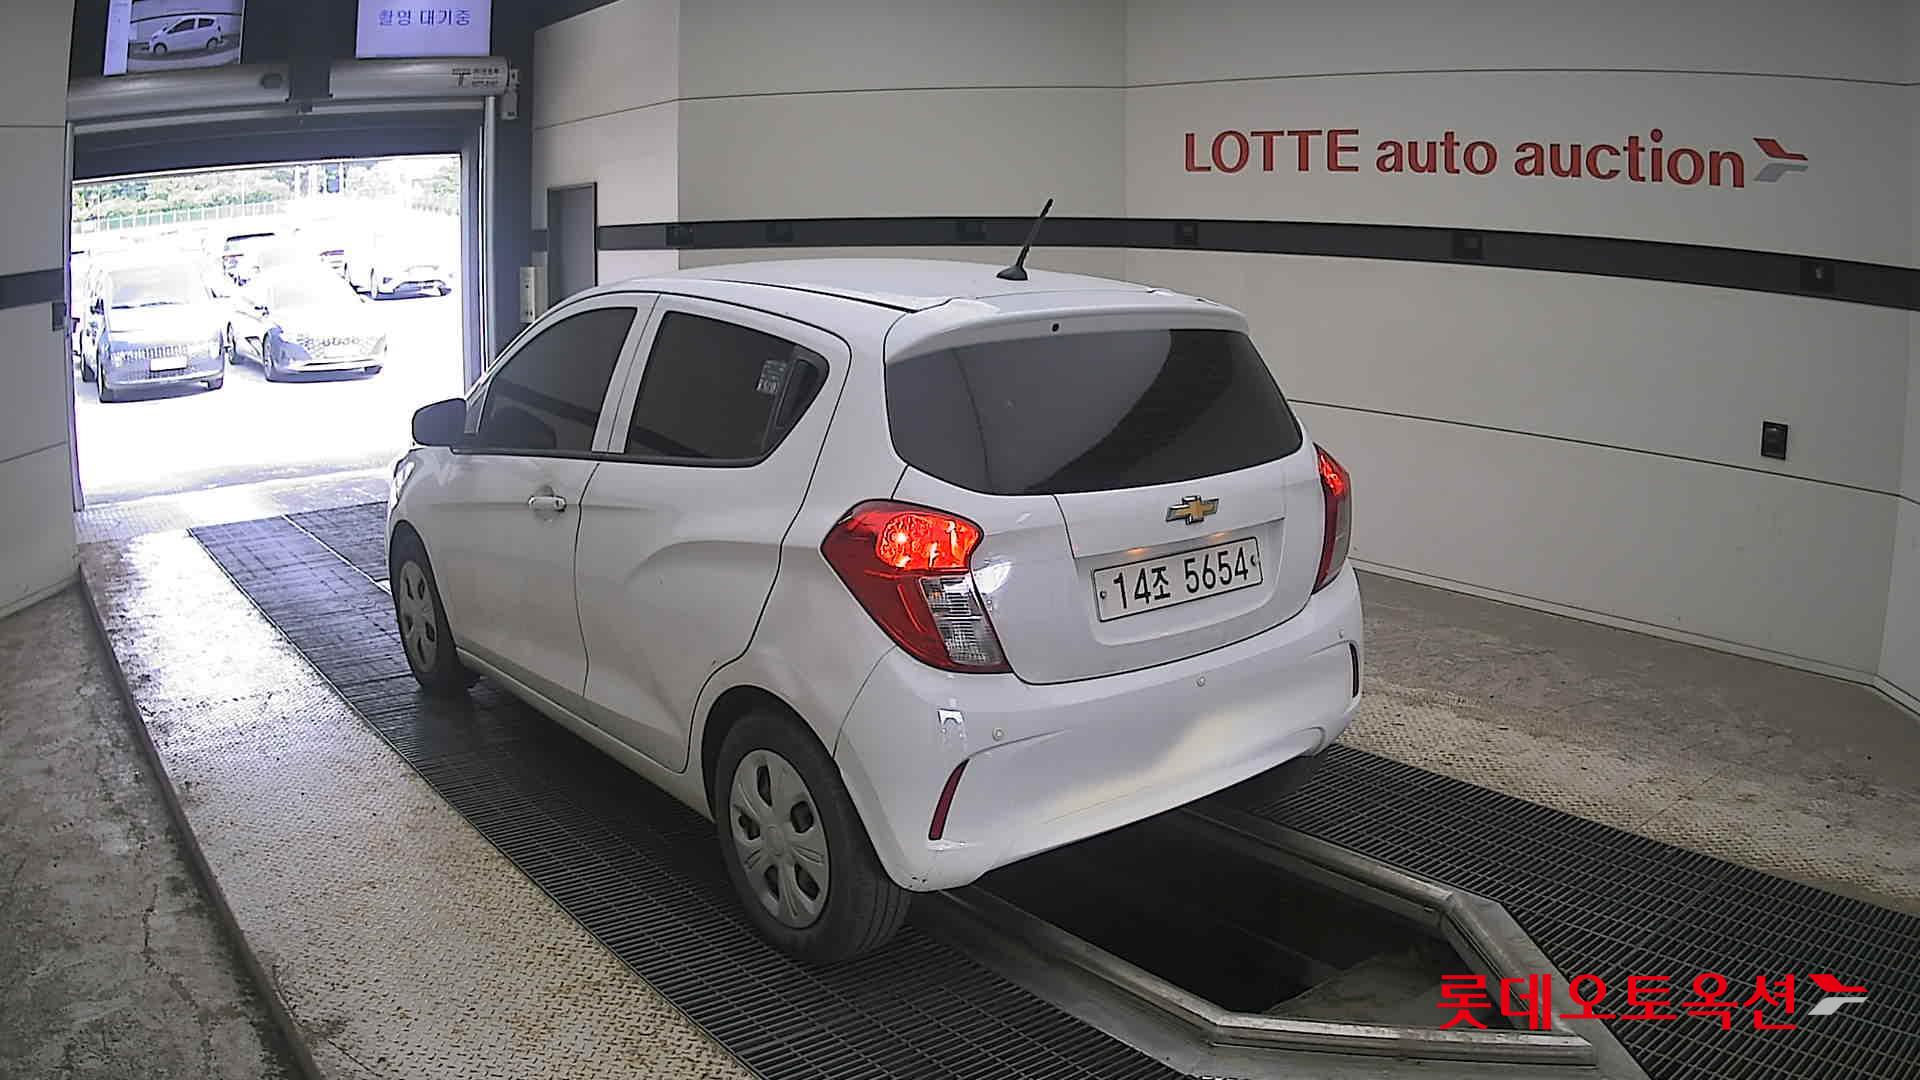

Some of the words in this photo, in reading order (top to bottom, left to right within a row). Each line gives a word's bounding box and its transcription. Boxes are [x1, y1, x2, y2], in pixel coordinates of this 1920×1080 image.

[419, 9, 471, 26] 대기중
[1185, 129, 1360, 173] LOTTE
[1376, 131, 1498, 175] auto
[1514, 129, 1746, 189] auction
[1113, 566, 1171, 609] 14조
[1184, 547, 1249, 593] 5654
